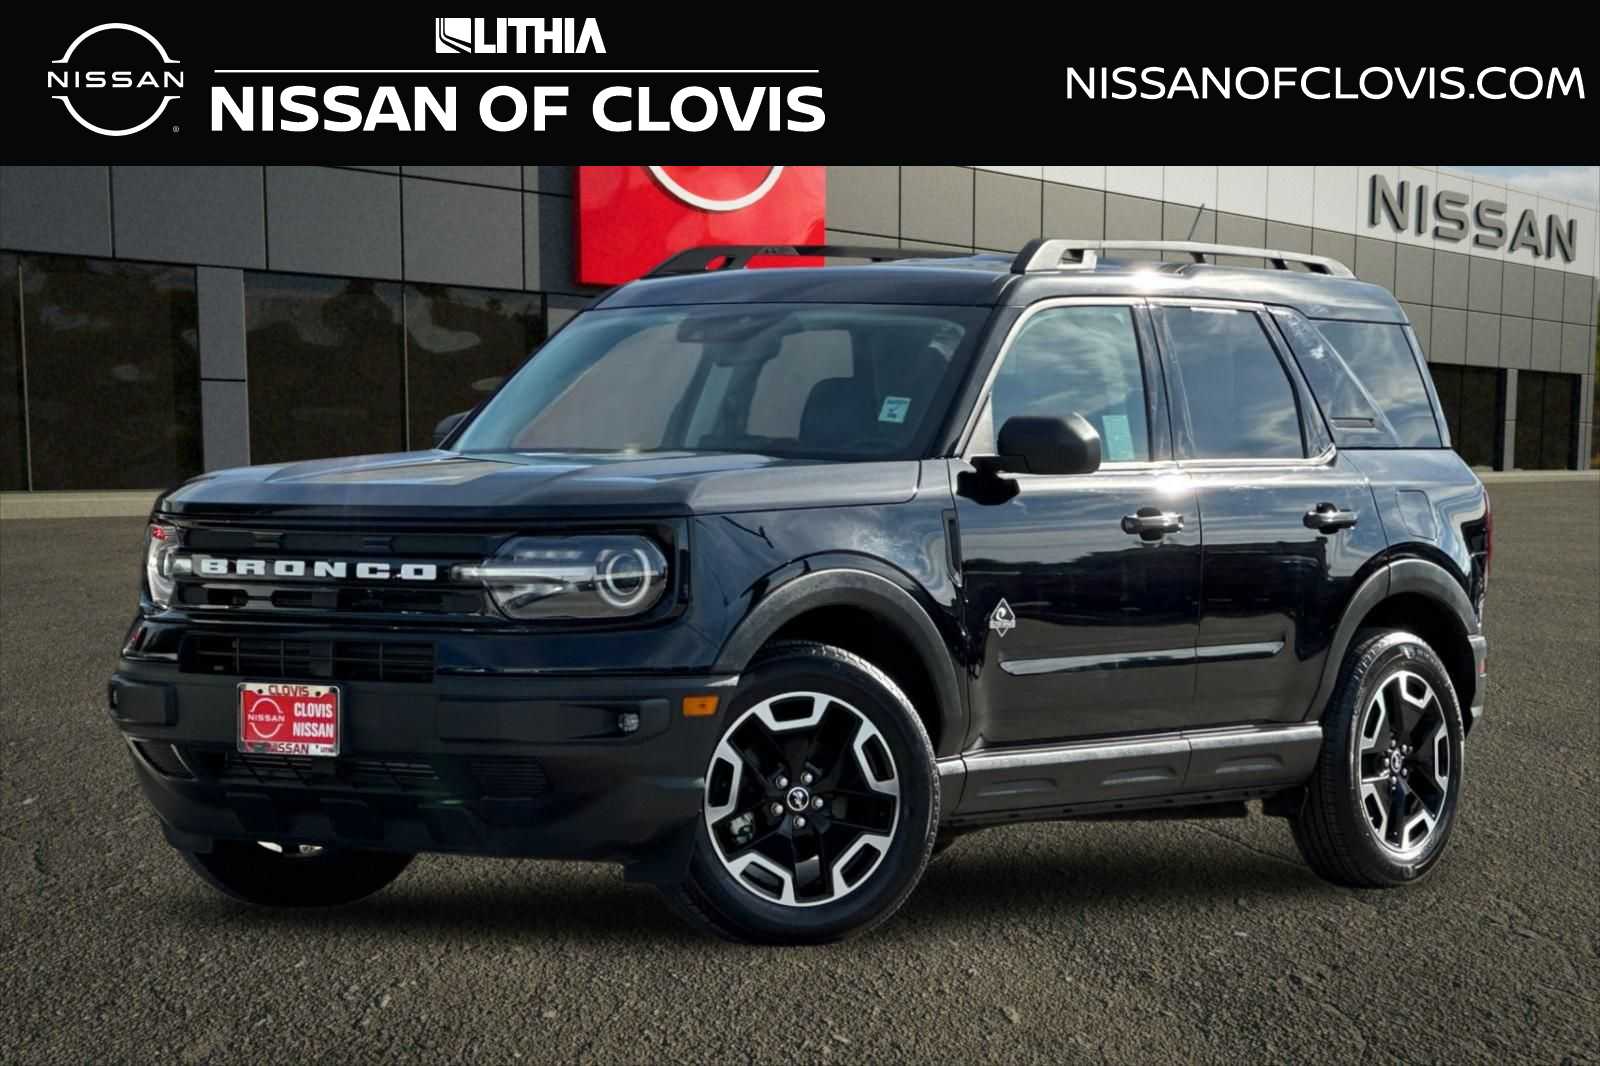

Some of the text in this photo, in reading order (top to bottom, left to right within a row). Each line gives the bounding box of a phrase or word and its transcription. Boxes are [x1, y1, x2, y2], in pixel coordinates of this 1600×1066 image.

[1368, 173, 1577, 263] NISSAN
[200, 558, 437, 580] BRONCO
[268, 685, 309, 697] CLOVIS
[247, 713, 286, 722] NISSAN
[293, 702, 333, 718] CLOVIS
[292, 722, 334, 738] NISSAN
[266, 742, 309, 754] ISSAN
